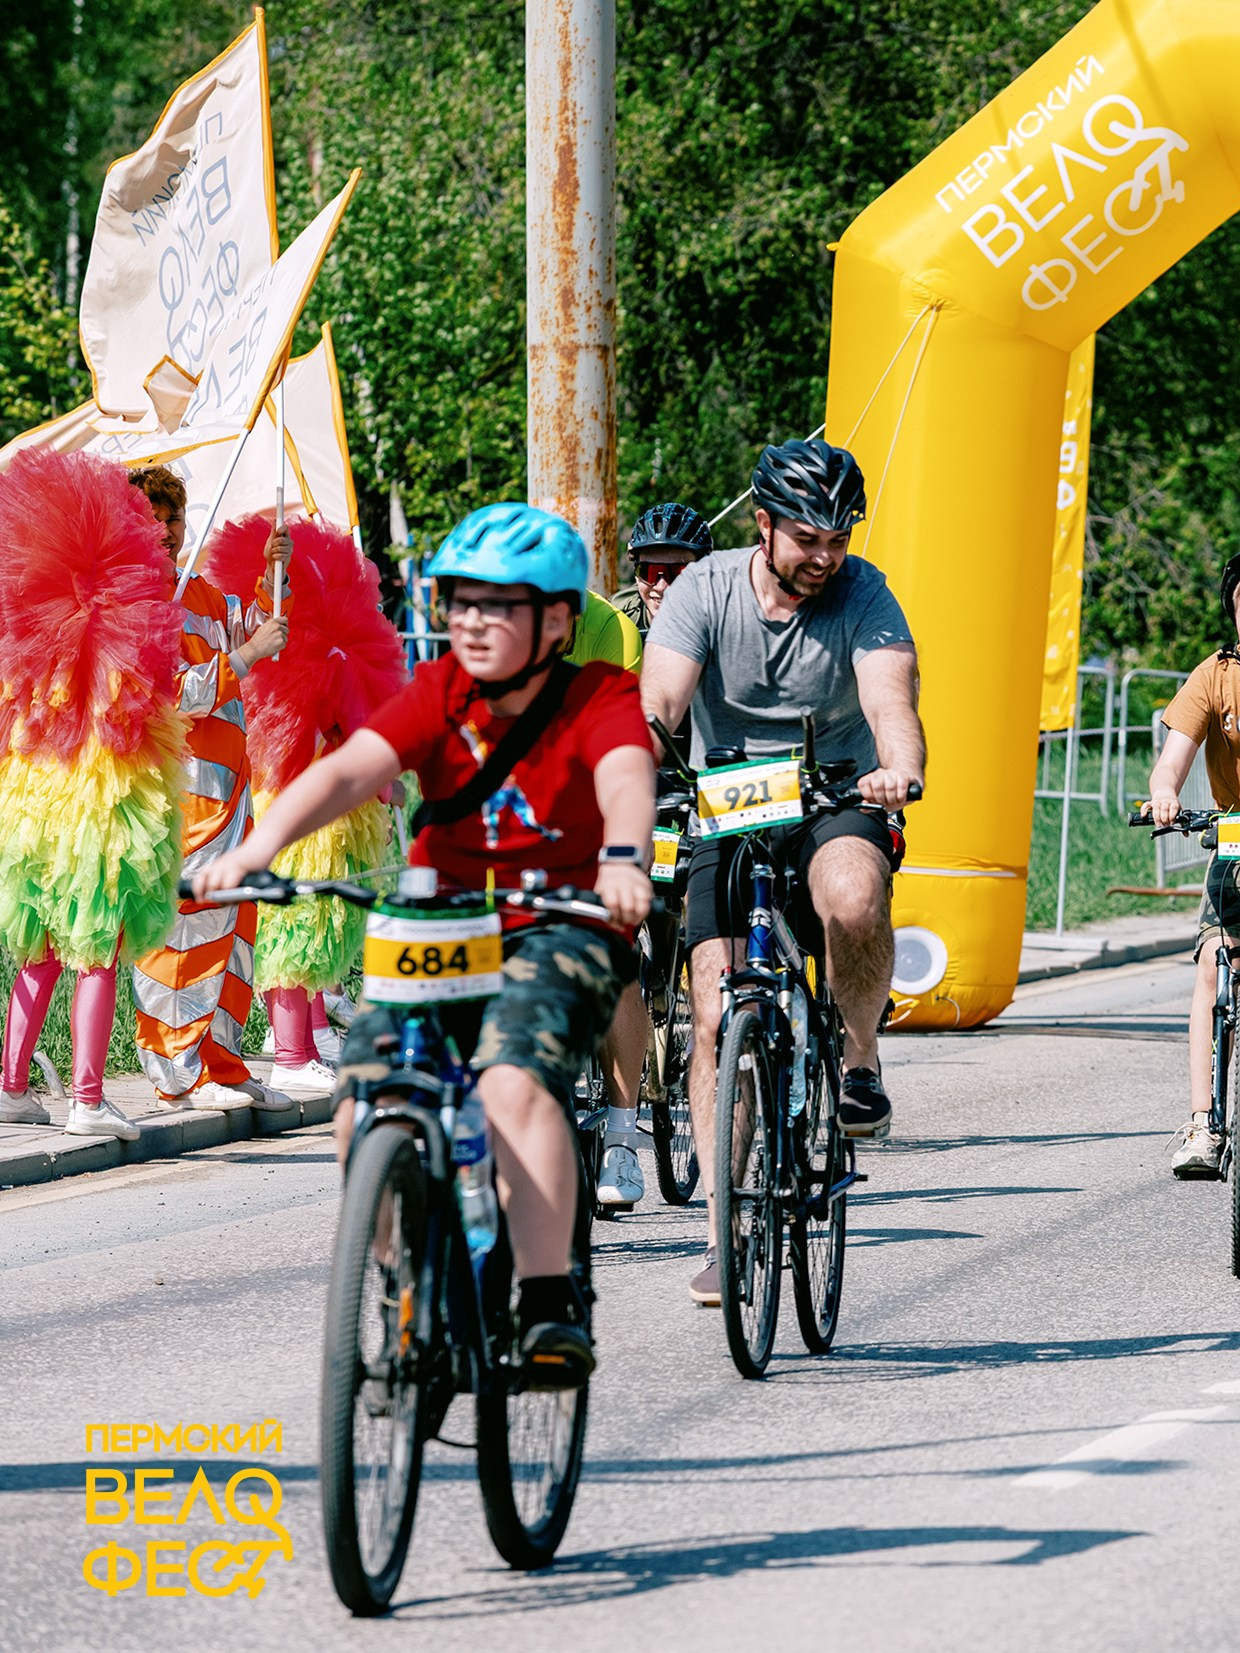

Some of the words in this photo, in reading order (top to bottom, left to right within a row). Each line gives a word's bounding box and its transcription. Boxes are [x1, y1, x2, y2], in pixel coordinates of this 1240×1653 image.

[934, 55, 1105, 213] ПЕРМСКИЙ
[724, 780, 773, 811] 921
[397, 944, 469, 975] 684
